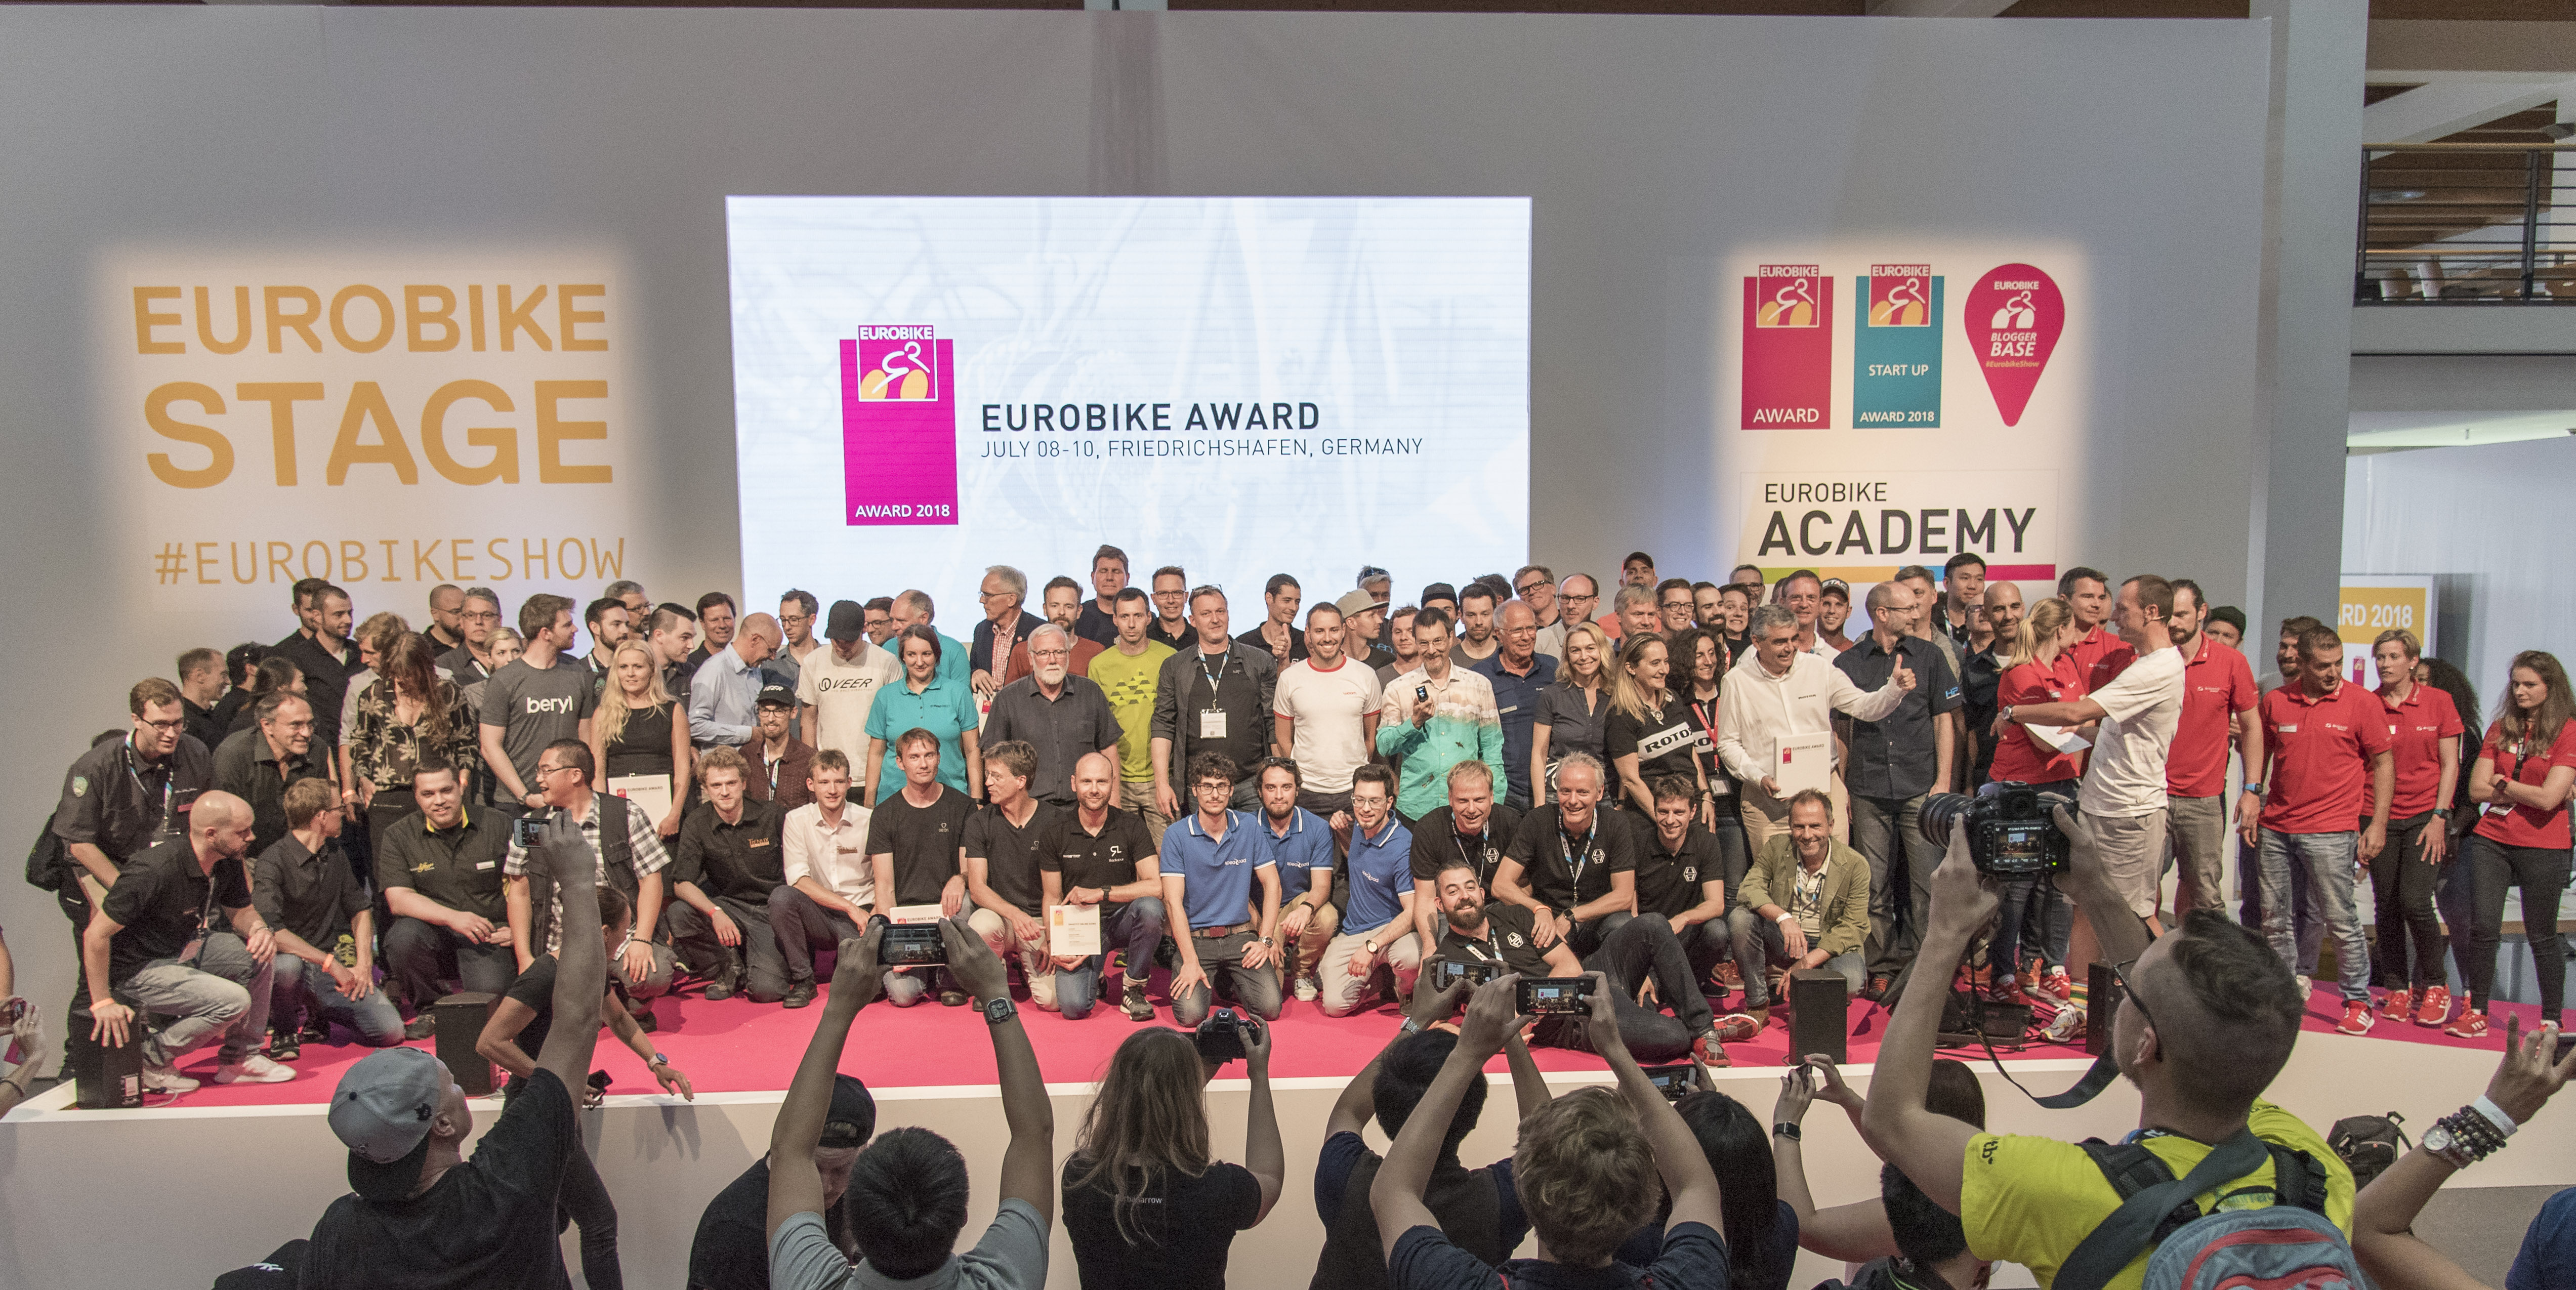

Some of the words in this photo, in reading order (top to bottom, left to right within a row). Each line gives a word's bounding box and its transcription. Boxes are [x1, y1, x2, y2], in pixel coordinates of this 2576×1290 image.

[1760, 267, 1818, 277] EUROBIKE
[1872, 266, 1930, 277] EUROBIKE
[1993, 280, 2040, 290] EUROBIKE
[133, 284, 609, 354] EUROBIKE
[859, 327, 934, 340] EUROBIKE
[1990, 332, 2037, 342] BLOGGER
[1990, 342, 2036, 357] BASE
[1868, 364, 1907, 376] START
[1912, 364, 1929, 376] UP
[1985, 360, 2040, 368] #EurobikeShow
[981, 403, 1172, 432] EUROBIKE
[1184, 402, 1319, 431] AWARD
[1753, 408, 1819, 423] AWARD
[1860, 411, 1905, 422] AWARD
[1907, 410, 1935, 422] 2018
[144, 379, 613, 489] STAGE
[980, 440, 1030, 458] JULY
[1037, 439, 1101, 461] 08-10,
[1108, 438, 1315, 460] FRIEDRICHSHAFEN,
[1320, 437, 1423, 455] GERMANY
[1765, 482, 1888, 503] EUROBIKE
[855, 505, 912, 518] AWARD
[916, 504, 950, 517] 2018
[1757, 508, 2036, 556] ACADEMY
[154, 537, 625, 585] #EUROBIKESHOW
[2371, 603, 2413, 629] 2018
[833, 678, 872, 689] VEER
[526, 695, 573, 714] beryl
